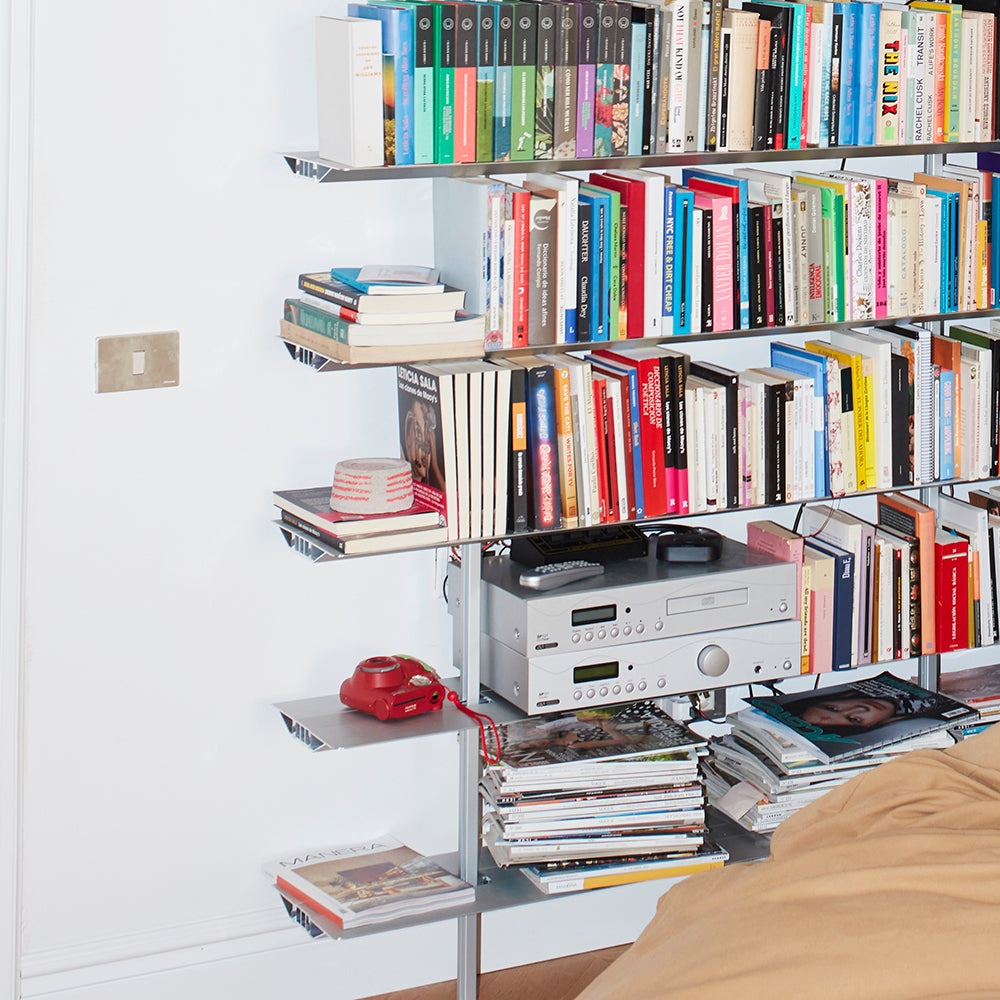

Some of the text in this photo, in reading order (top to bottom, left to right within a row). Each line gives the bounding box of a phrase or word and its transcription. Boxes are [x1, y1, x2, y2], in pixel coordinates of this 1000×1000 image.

[676, 5, 684, 22] NOT
[916, 27, 924, 66] TRANSIT
[675, 71, 683, 81] OF
[881, 40, 900, 117] THE NIX
[915, 104, 923, 141] RACHEL
[581, 220, 589, 263] DAUGHTER
[666, 235, 674, 256] FREE
[665, 264, 673, 283] DIRT
[716, 262, 732, 303] XAVIER
[579, 304, 587, 318] Dey
[665, 284, 673, 312] CHEAP
[419, 374, 437, 393] SALA
[642, 383, 650, 416] POÉTICA
[647, 371, 657, 424] COMPOSICIÓN
[653, 365, 662, 429] DICCIONARIO DE
